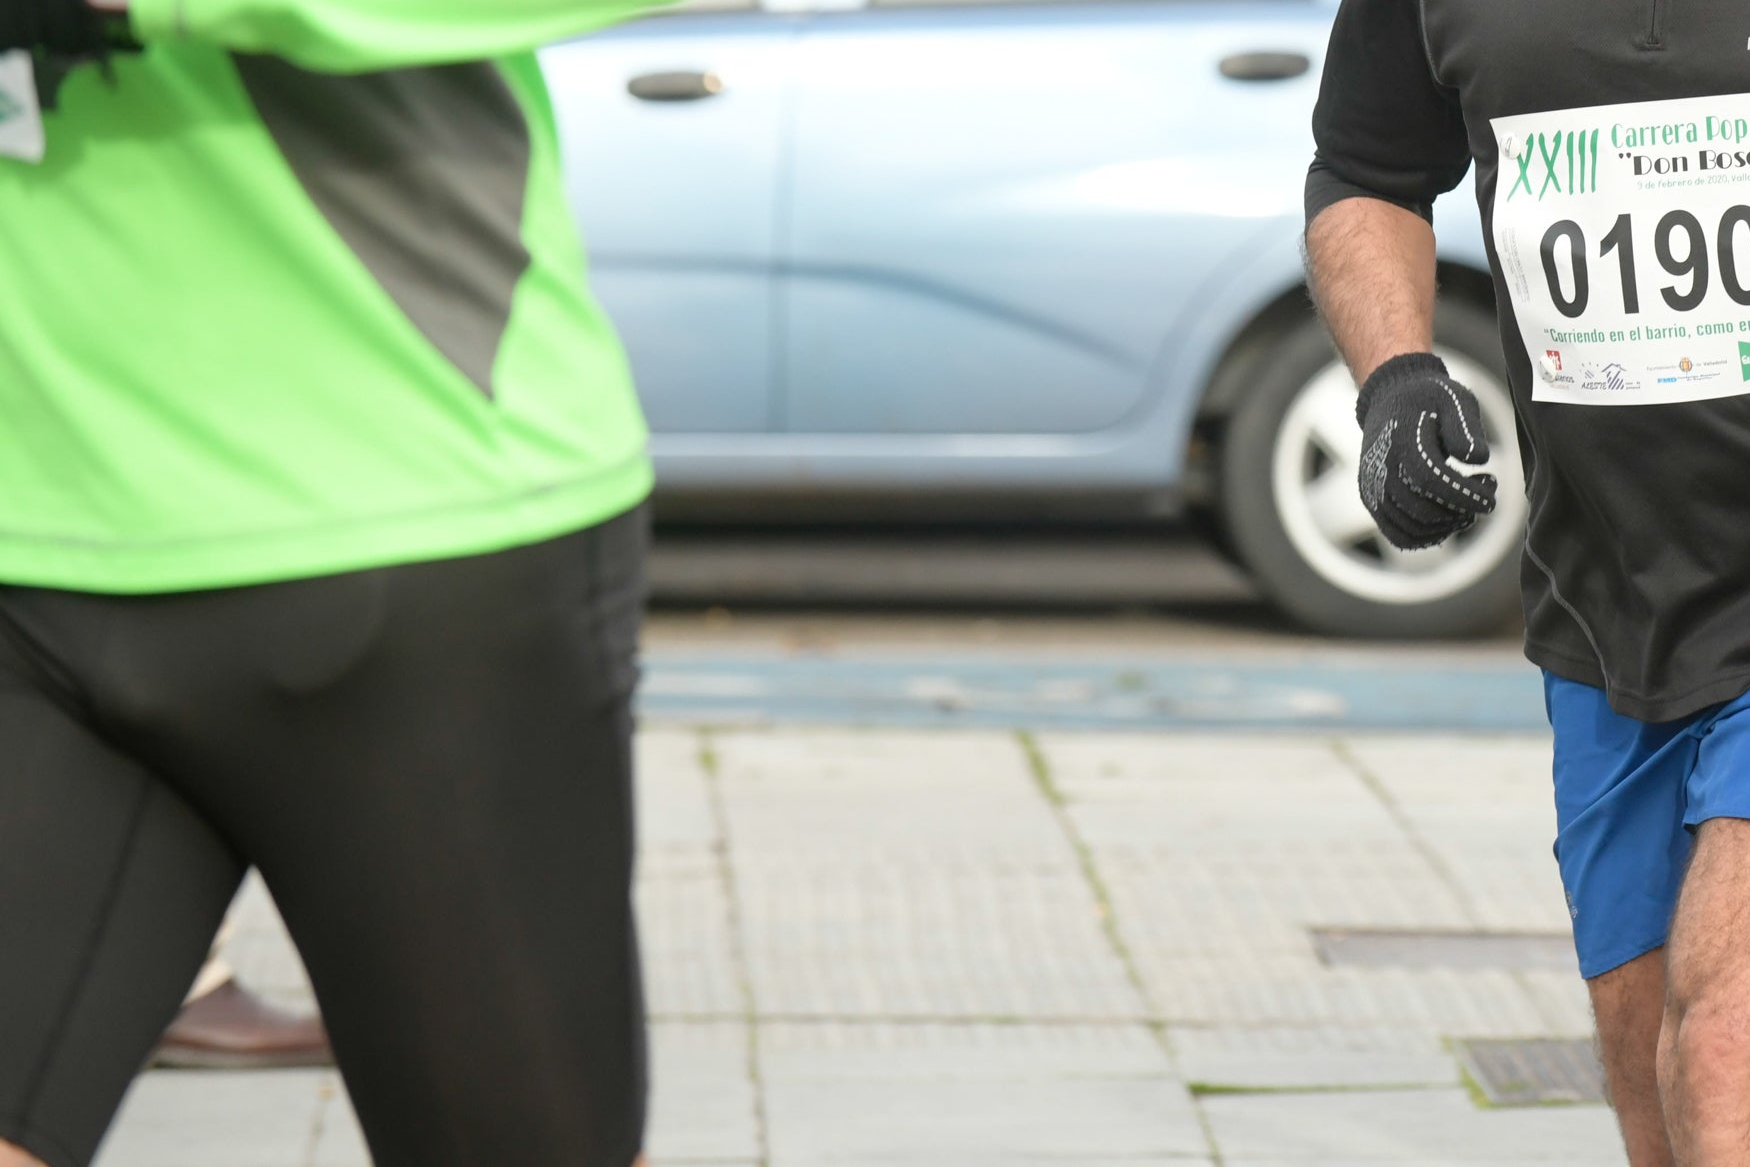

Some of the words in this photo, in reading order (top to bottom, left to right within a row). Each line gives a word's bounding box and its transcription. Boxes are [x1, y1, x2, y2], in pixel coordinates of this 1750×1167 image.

[1507, 127, 1600, 203] XXIII
[1610, 121, 1698, 149] Carrera
[1617, 151, 1689, 176] "Don
[1636, 181, 1644, 191] 9
[1644, 180, 1656, 190] de
[1657, 178, 1693, 190] febrero
[1694, 176, 1706, 186] de
[1706, 173, 1731, 185] 2020,
[1543, 327, 1606, 344] "Corriendo
[1609, 329, 1625, 342] en
[1629, 327, 1642, 341] el
[1646, 325, 1692, 341] barrio,
[1696, 322, 1734, 336] como
